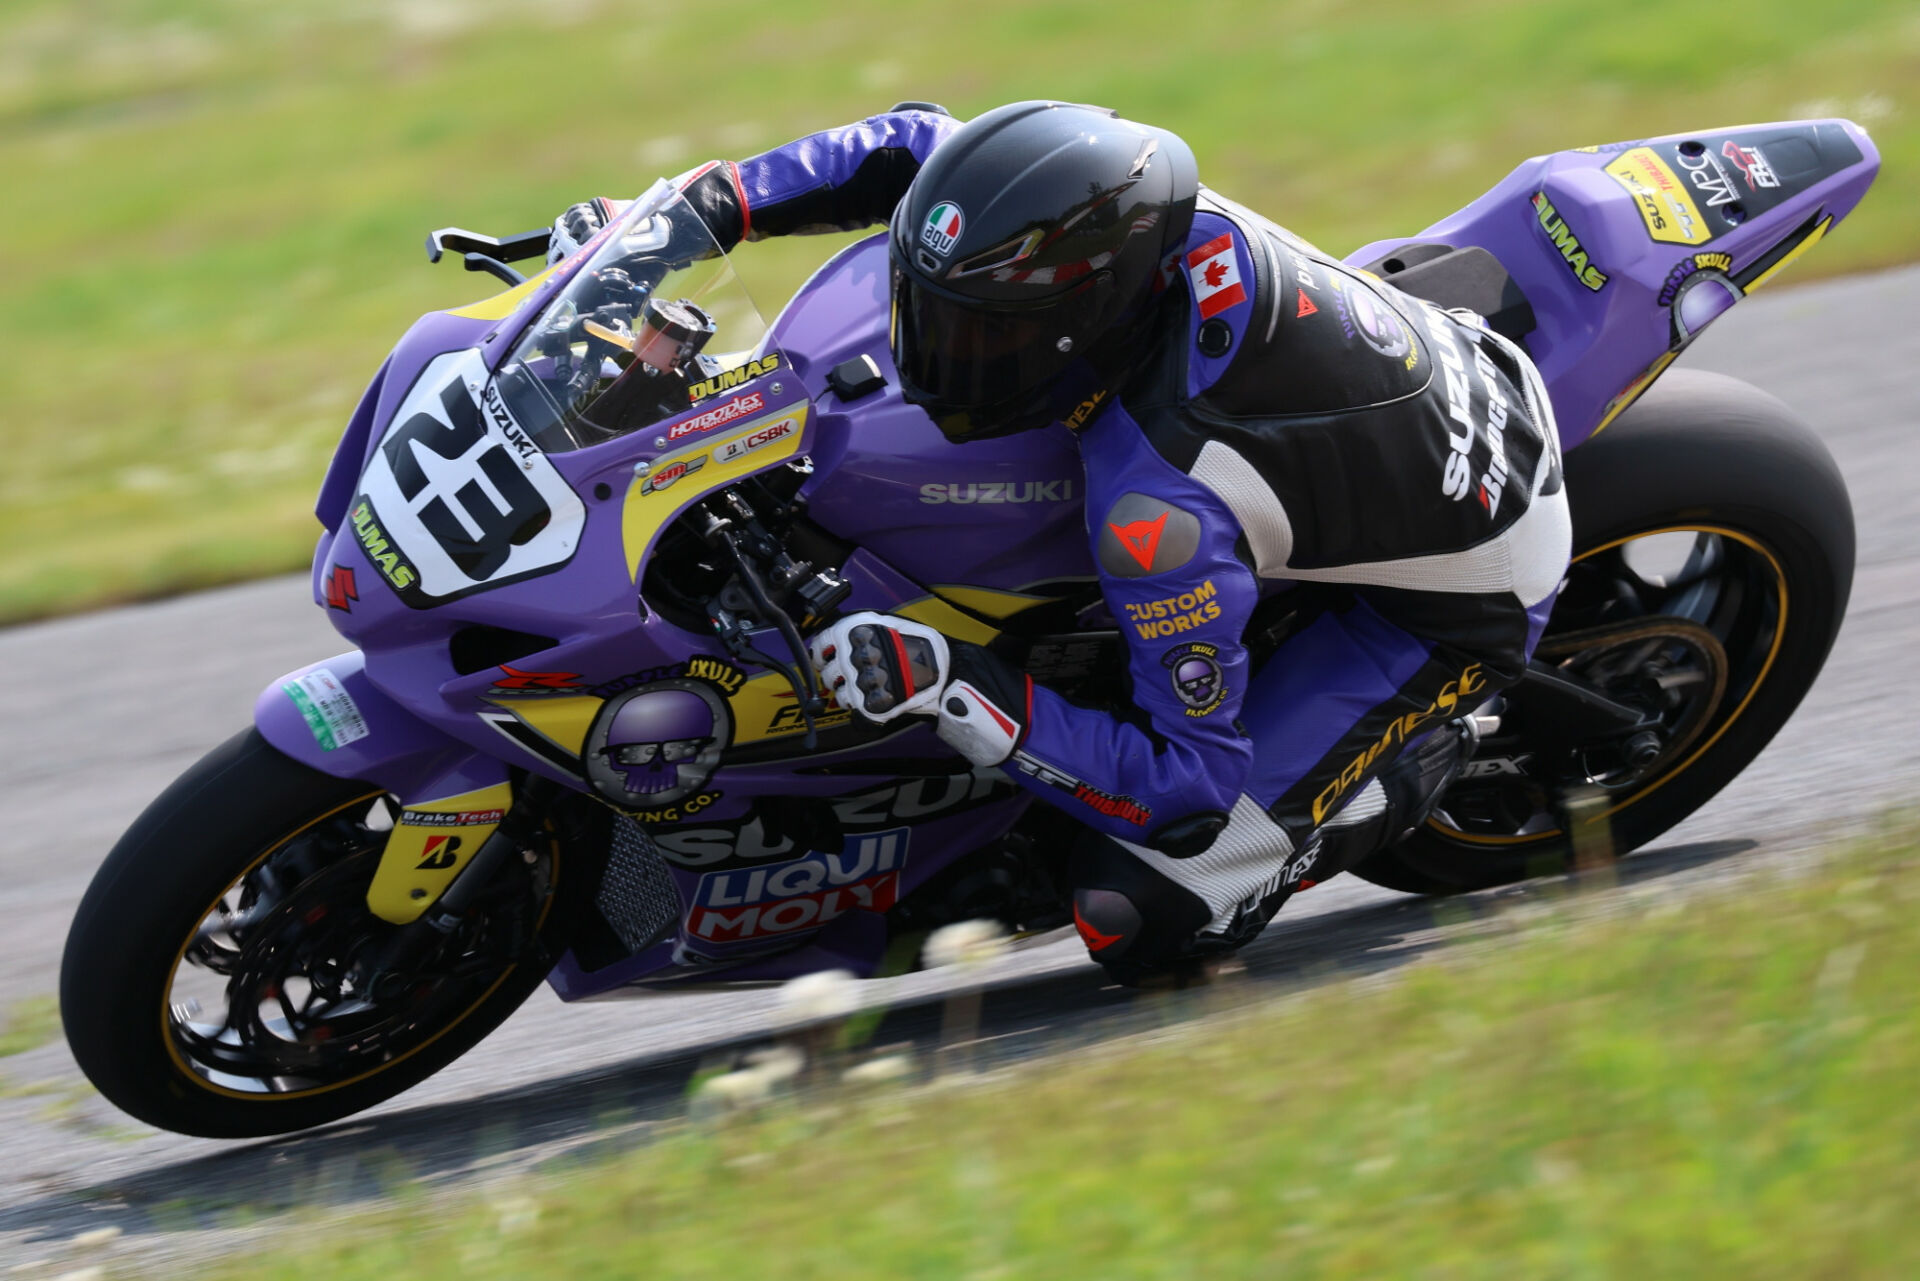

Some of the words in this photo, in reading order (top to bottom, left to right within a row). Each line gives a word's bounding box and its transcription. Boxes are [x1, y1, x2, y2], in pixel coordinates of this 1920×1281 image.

[1533, 193, 1607, 290] DUMAS
[1695, 253, 1732, 271] SKULL
[689, 354, 779, 402] DUMAS
[484, 385, 541, 460] SUZUKI
[747, 421, 791, 449] CSBK
[382, 374, 551, 582] 23
[919, 480, 1072, 504] SUZUKI
[352, 502, 415, 590] DUMAS
[1125, 579, 1218, 621] CUSTOM
[1136, 600, 1222, 640] WORKS
[1191, 645, 1217, 657] SKULL
[686, 658, 744, 693] SKULL
[707, 834, 899, 907] LIQUI
[697, 876, 892, 938] MOLY
